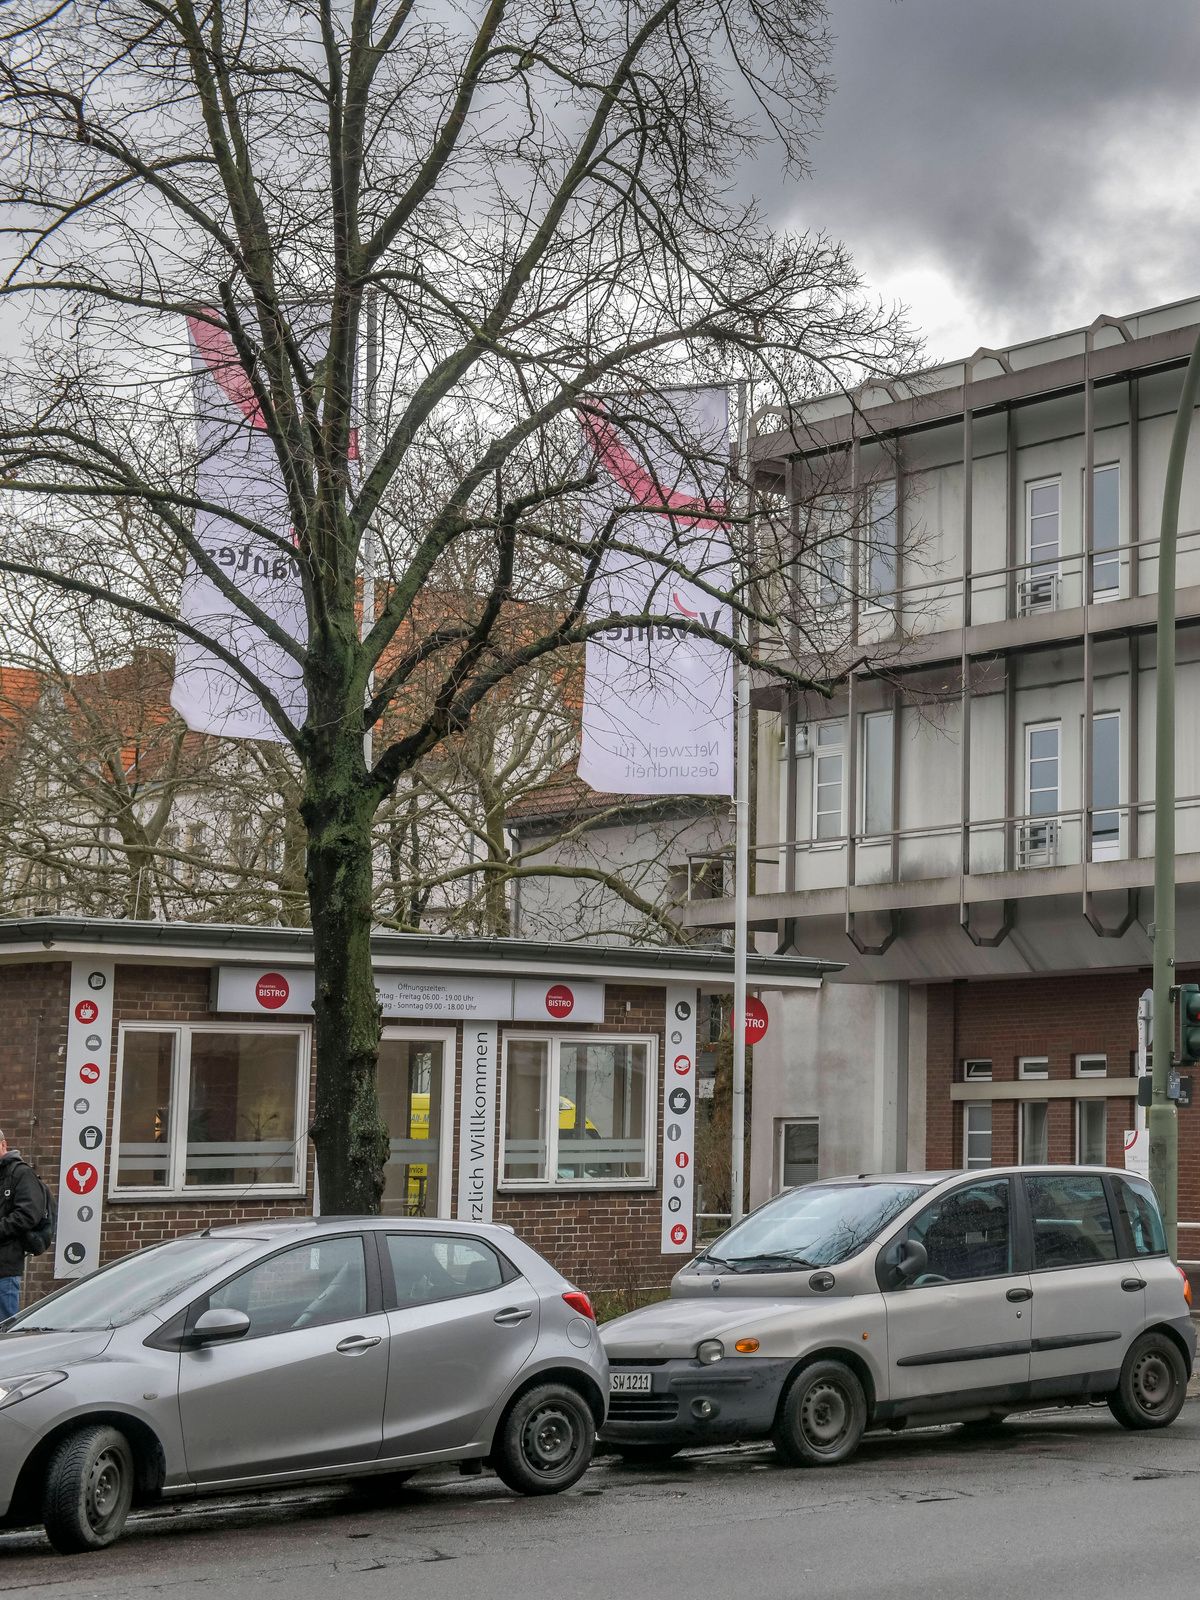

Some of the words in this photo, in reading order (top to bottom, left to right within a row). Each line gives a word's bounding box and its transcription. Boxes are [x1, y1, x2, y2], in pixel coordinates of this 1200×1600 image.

[397, 982, 448, 993] Öffnungszeiten:
[258, 989, 287, 998] BISTRO
[375, 993, 394, 1001] ontag
[399, 993, 421, 1001] Freitag
[397, 1002, 424, 1011] Sonntag
[548, 999, 572, 1008] BISTRO
[744, 1018, 765, 1028] STRO
[470, 1032, 488, 1161] Willkommen
[468, 1168, 485, 1223] rzlich
[612, 1375, 626, 1390] SW
[626, 1375, 649, 1390] 1211
